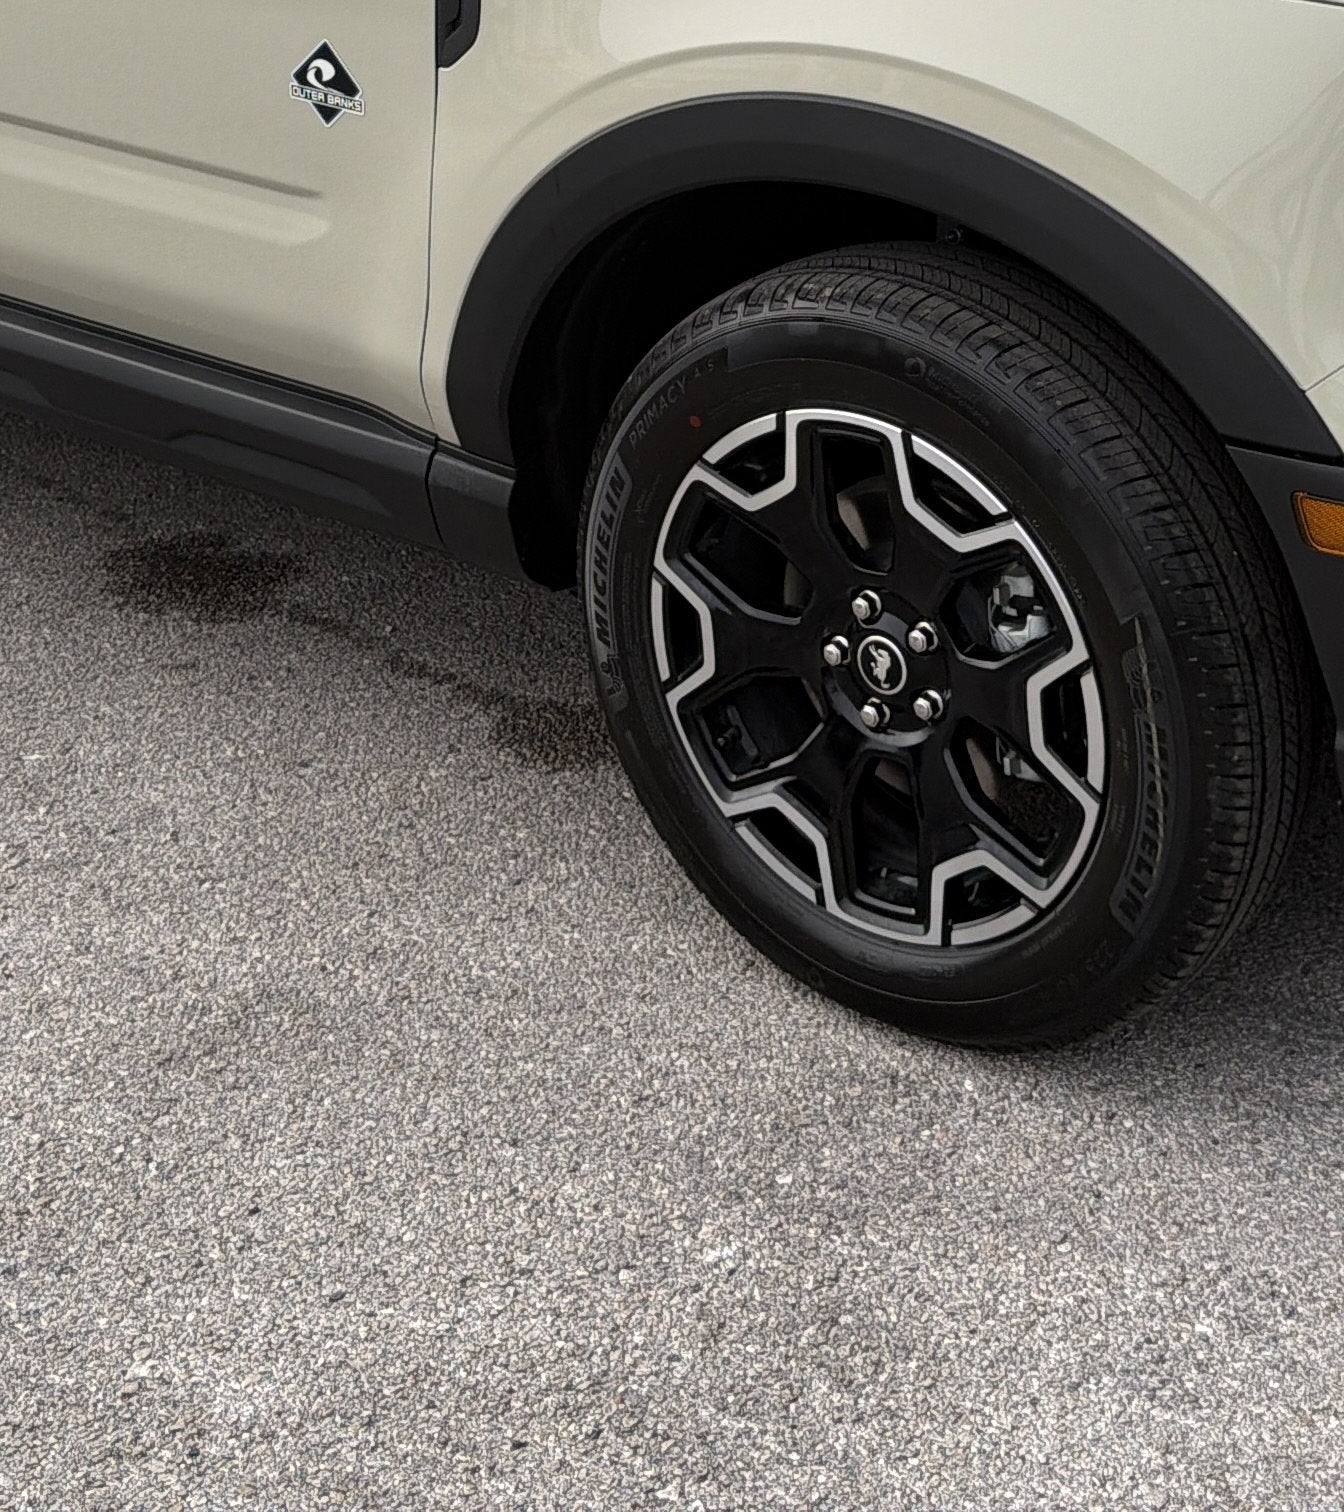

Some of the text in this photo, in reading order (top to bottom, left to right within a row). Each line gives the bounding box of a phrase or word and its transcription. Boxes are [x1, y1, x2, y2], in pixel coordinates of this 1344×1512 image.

[293, 86, 361, 112] OUTER BANKS
[628, 377, 688, 450] PRIMACY
[593, 466, 626, 649] MICHELIN
